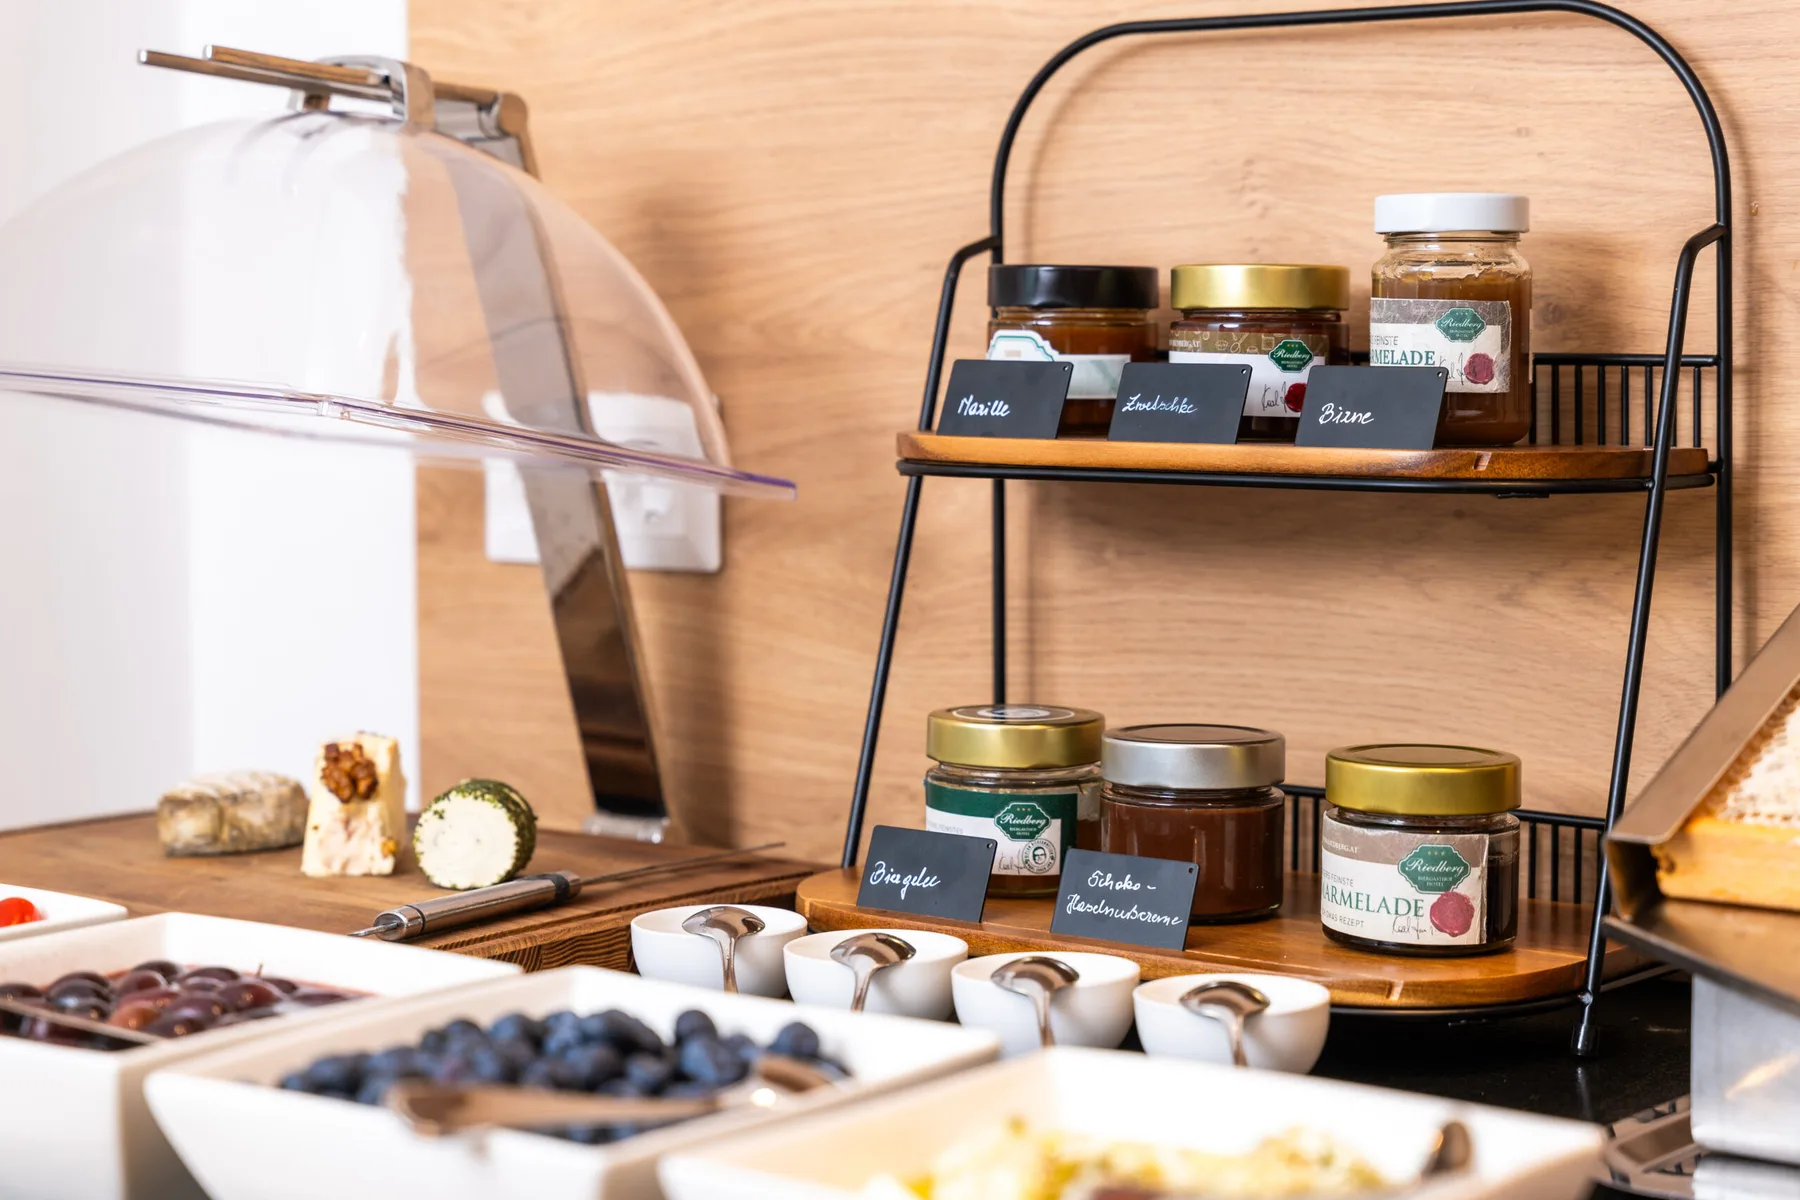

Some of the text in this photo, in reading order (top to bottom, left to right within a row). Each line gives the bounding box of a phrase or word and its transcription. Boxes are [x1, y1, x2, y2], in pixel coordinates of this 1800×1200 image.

[1440, 317, 1482, 331] Riedberg
[1273, 348, 1311, 362] Riedberg
[999, 812, 1047, 829] Riedberg
[1405, 857, 1464, 878] Riedberg
[1331, 873, 1355, 888] FEINSTE
[1339, 915, 1365, 929] REZEPT
